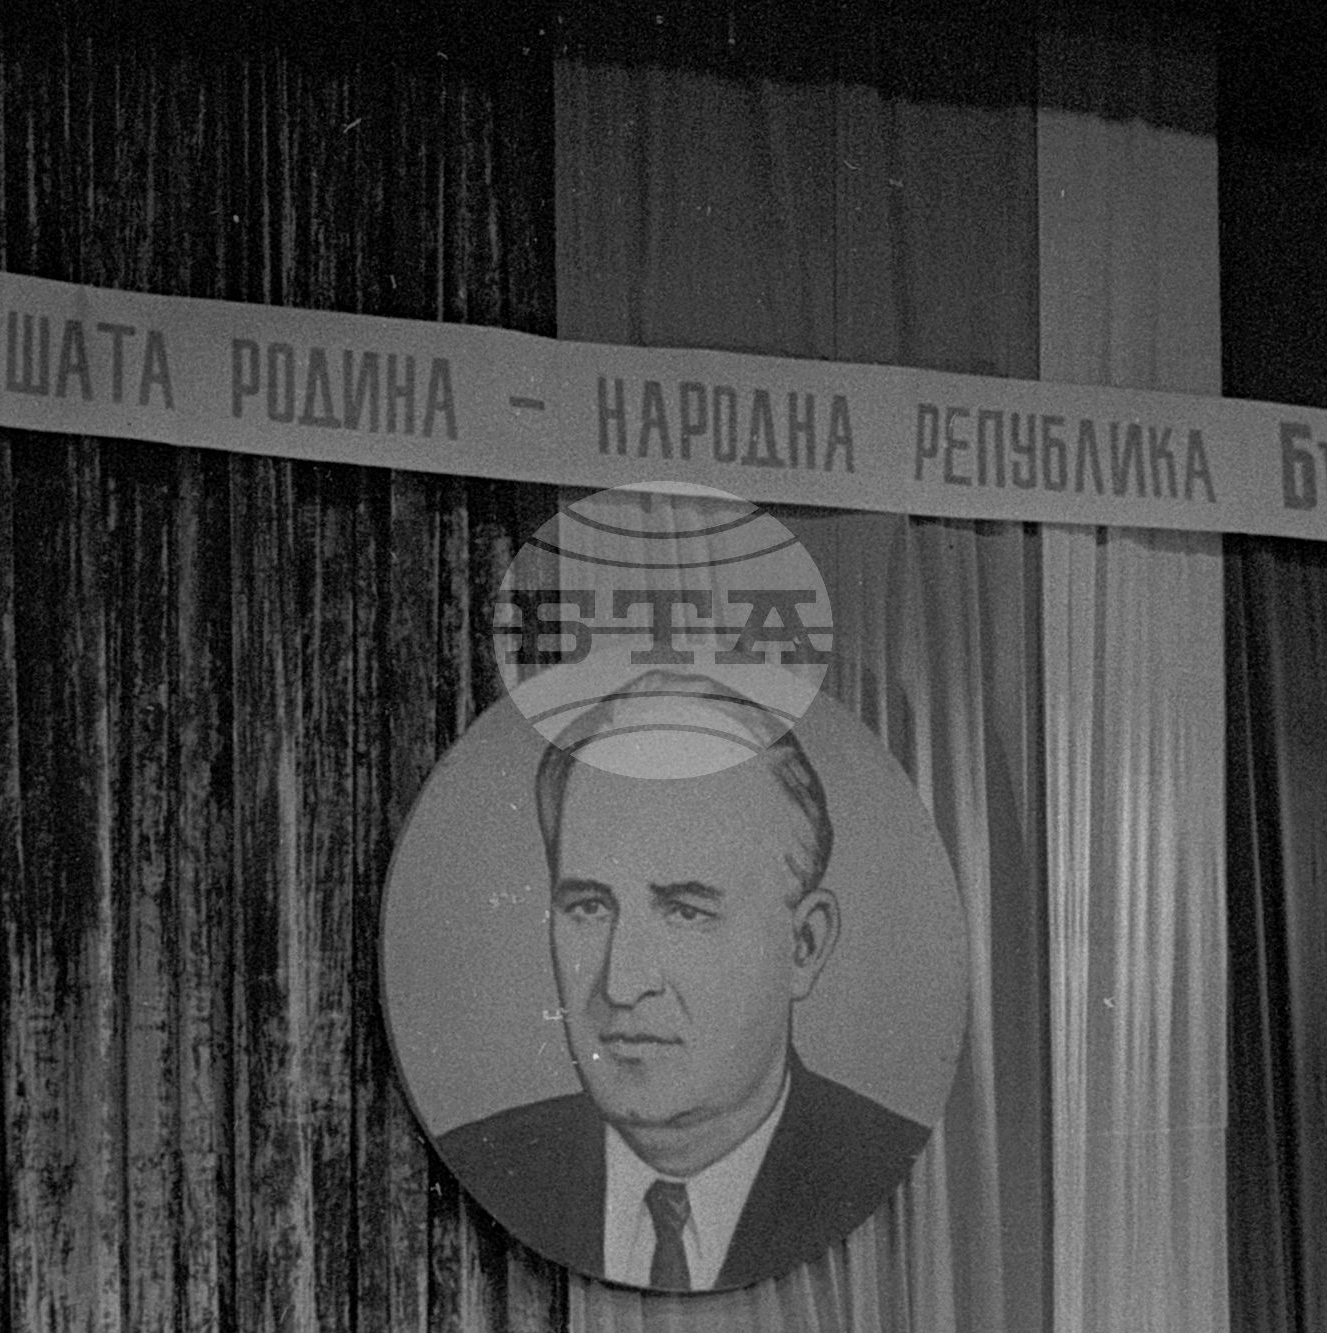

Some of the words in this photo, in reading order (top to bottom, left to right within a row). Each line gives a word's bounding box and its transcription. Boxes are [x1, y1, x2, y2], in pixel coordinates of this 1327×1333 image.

[231, 336, 459, 440] РОДИНА
[596, 375, 856, 474] НАРОДНА
[915, 402, 1216, 503] РЕПУБЛИКА
